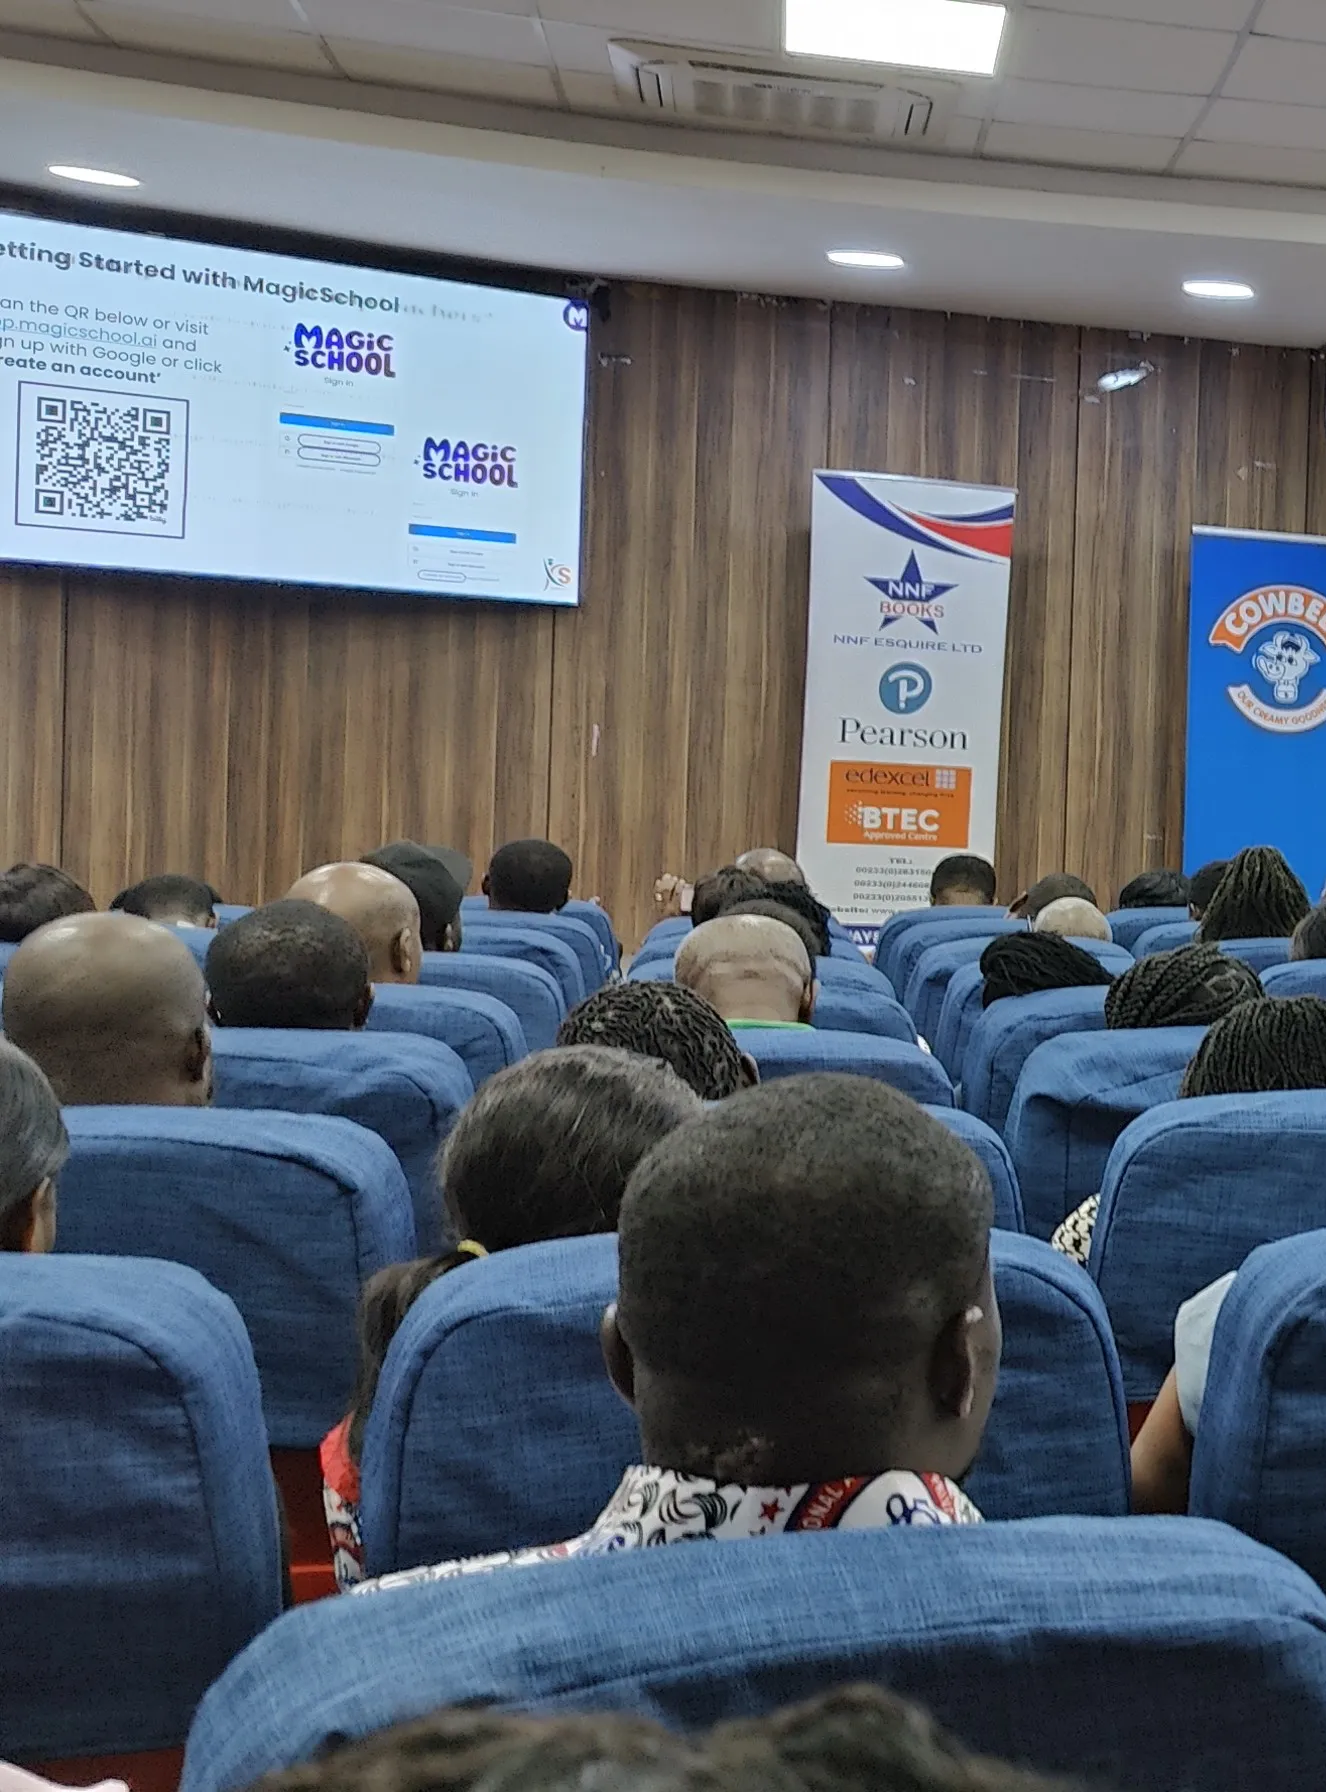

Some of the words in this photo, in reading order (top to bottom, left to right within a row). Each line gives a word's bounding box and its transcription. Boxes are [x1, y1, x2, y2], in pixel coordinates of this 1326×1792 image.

[78, 251, 176, 281] Started
[182, 267, 237, 290] with
[243, 275, 399, 313] MagicSchool
[30, 299, 59, 316] the
[64, 304, 89, 320] QR
[95, 307, 148, 327] below
[153, 316, 171, 331] or
[175, 319, 209, 336] visit
[0, 317, 157, 347] p.magicschool.ai
[162, 337, 197, 352] and
[0, 356, 47, 370] eate
[51, 360, 75, 374] an
[20, 338, 45, 355] up
[49, 340, 88, 357] with
[92, 345, 157, 368] Google
[161, 355, 180, 368] or
[183, 356, 222, 374] click
[294, 350, 396, 379] SCHOOL
[423, 462, 519, 489] SCHOOL
[888, 580, 935, 599] NNF
[879, 601, 945, 618] BOOKS
[833, 634, 870, 646] NNF
[874, 637, 948, 651] ESQUIRE
[952, 642, 982, 654] LTD
[1237, 690, 1254, 709] OUR
[1253, 706, 1290, 725] CREAMY
[838, 716, 968, 750] Pearson
[845, 767, 929, 787] edexcel
[863, 806, 940, 832] BTEC
[863, 830, 906, 842] Approved
[908, 832, 938, 842] Centre
